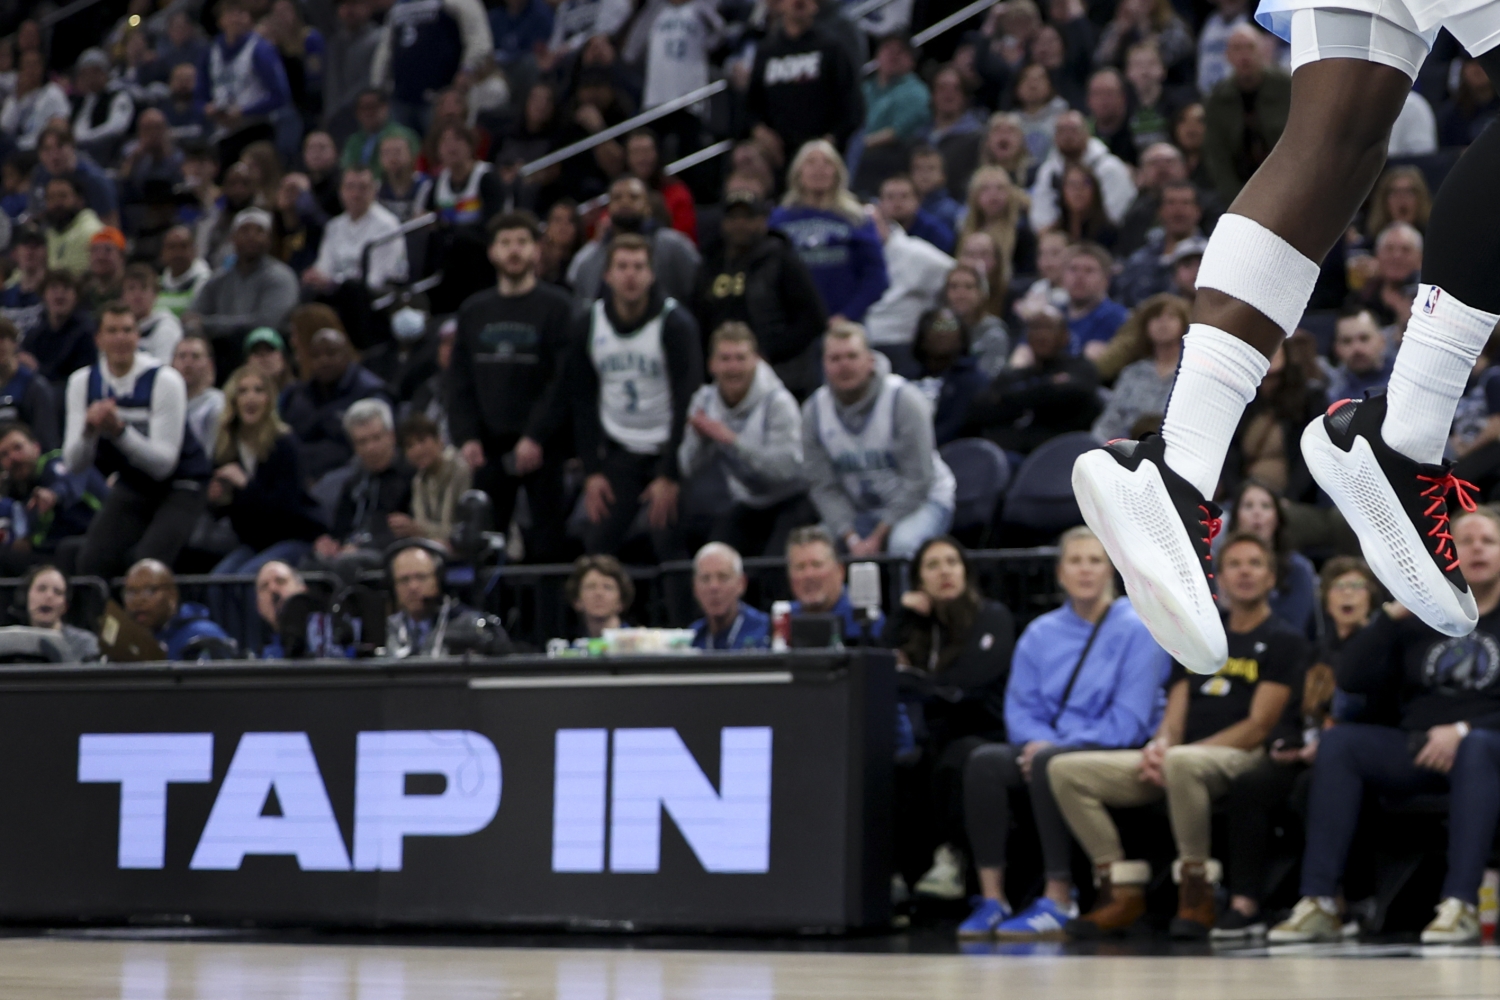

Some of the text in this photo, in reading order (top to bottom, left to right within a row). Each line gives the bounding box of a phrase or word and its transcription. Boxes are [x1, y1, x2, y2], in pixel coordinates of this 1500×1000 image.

[764, 50, 823, 88] DOPE
[77, 726, 772, 873] TAP IN
